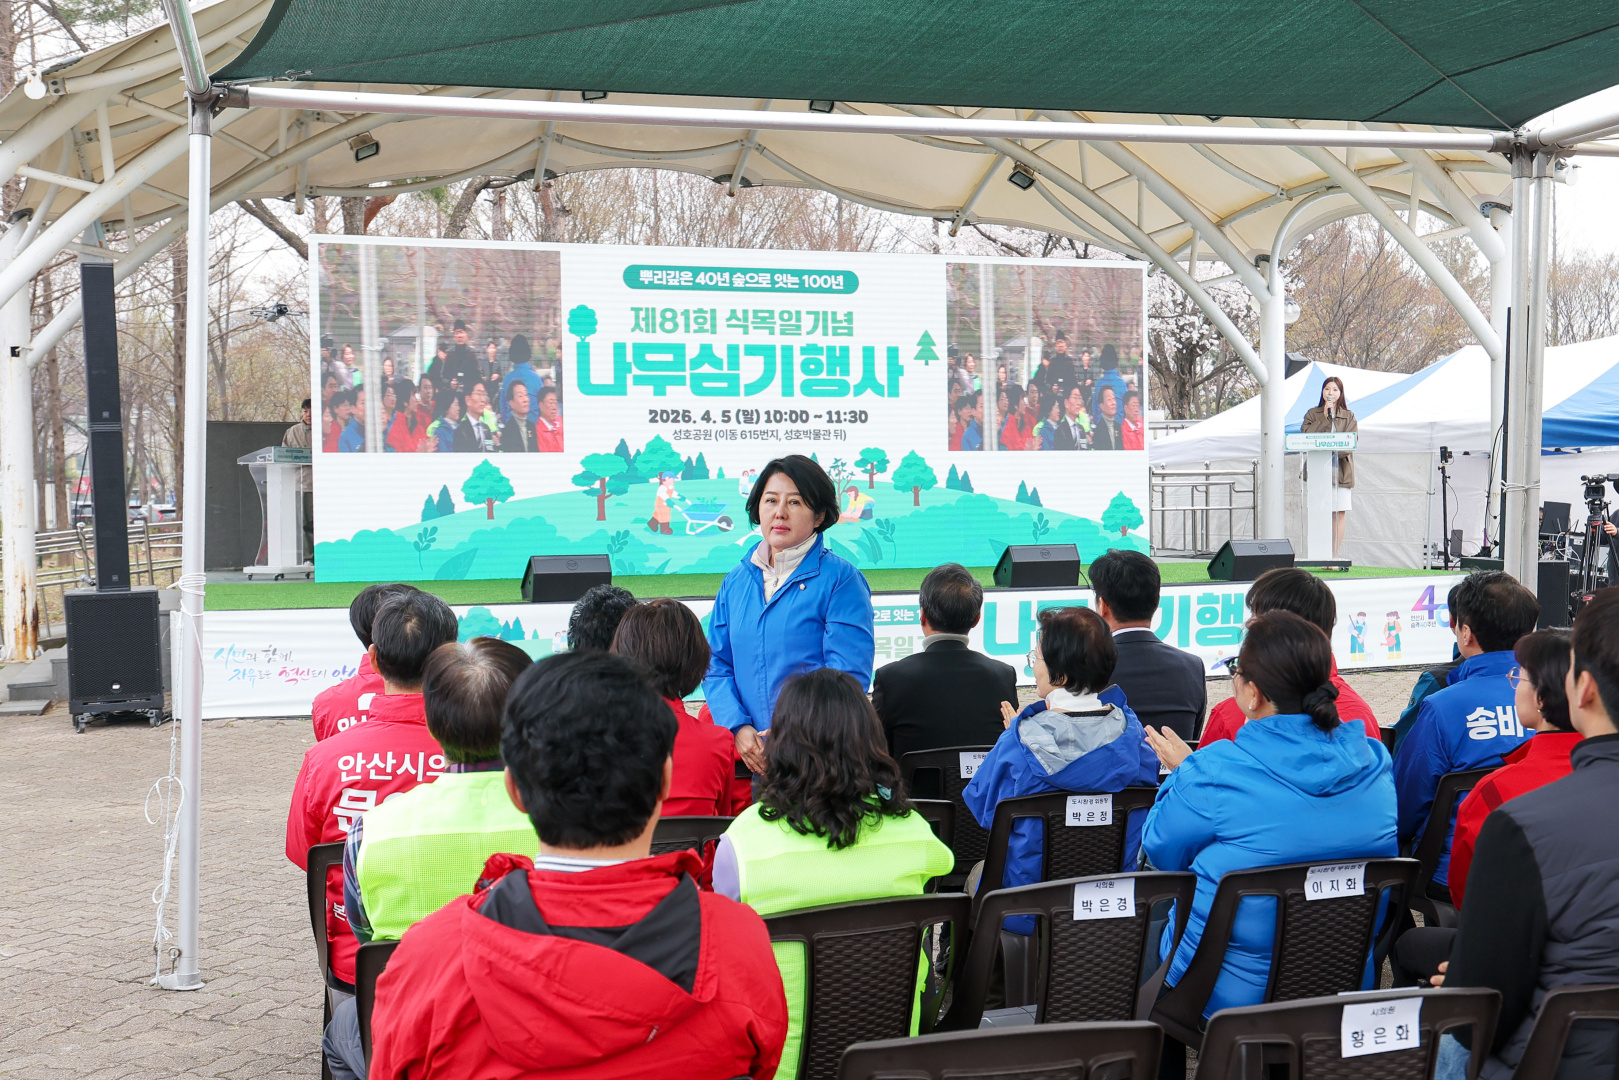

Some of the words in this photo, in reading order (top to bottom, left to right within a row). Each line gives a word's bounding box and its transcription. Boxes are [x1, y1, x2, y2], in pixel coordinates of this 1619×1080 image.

[639, 269, 694, 286] 뿌리깊은
[695, 271, 730, 287] 40년
[732, 273, 772, 288] 숲으로
[774, 274, 800, 289] 잇는
[802, 275, 844, 290] 100년
[630, 306, 718, 335] 제81회
[576, 341, 905, 398] 나무심기행사
[648, 409, 697, 424] 2026.
[700, 409, 717, 424] 4.
[721, 410, 732, 424] 5
[735, 408, 761, 425] (일)
[764, 409, 810, 424] 10:00
[826, 409, 869, 424] 11:30
[672, 429, 713, 441] 성호공원
[714, 429, 739, 442] (이동
[740, 429, 782, 442] 615번지,
[783, 429, 832, 441] 성호박물관
[832, 429, 847, 442] 뒤)
[893, 608, 915, 622] 잇는
[213, 643, 259, 669] 시민과
[874, 636, 925, 659] 목일
[227, 665, 273, 689] 자유로운
[278, 666, 328, 686] 혁신도시
[1466, 705, 1536, 740] 송비
[1095, 881, 1115, 889] 시의원
[1371, 1006, 1396, 1016] 시의원
